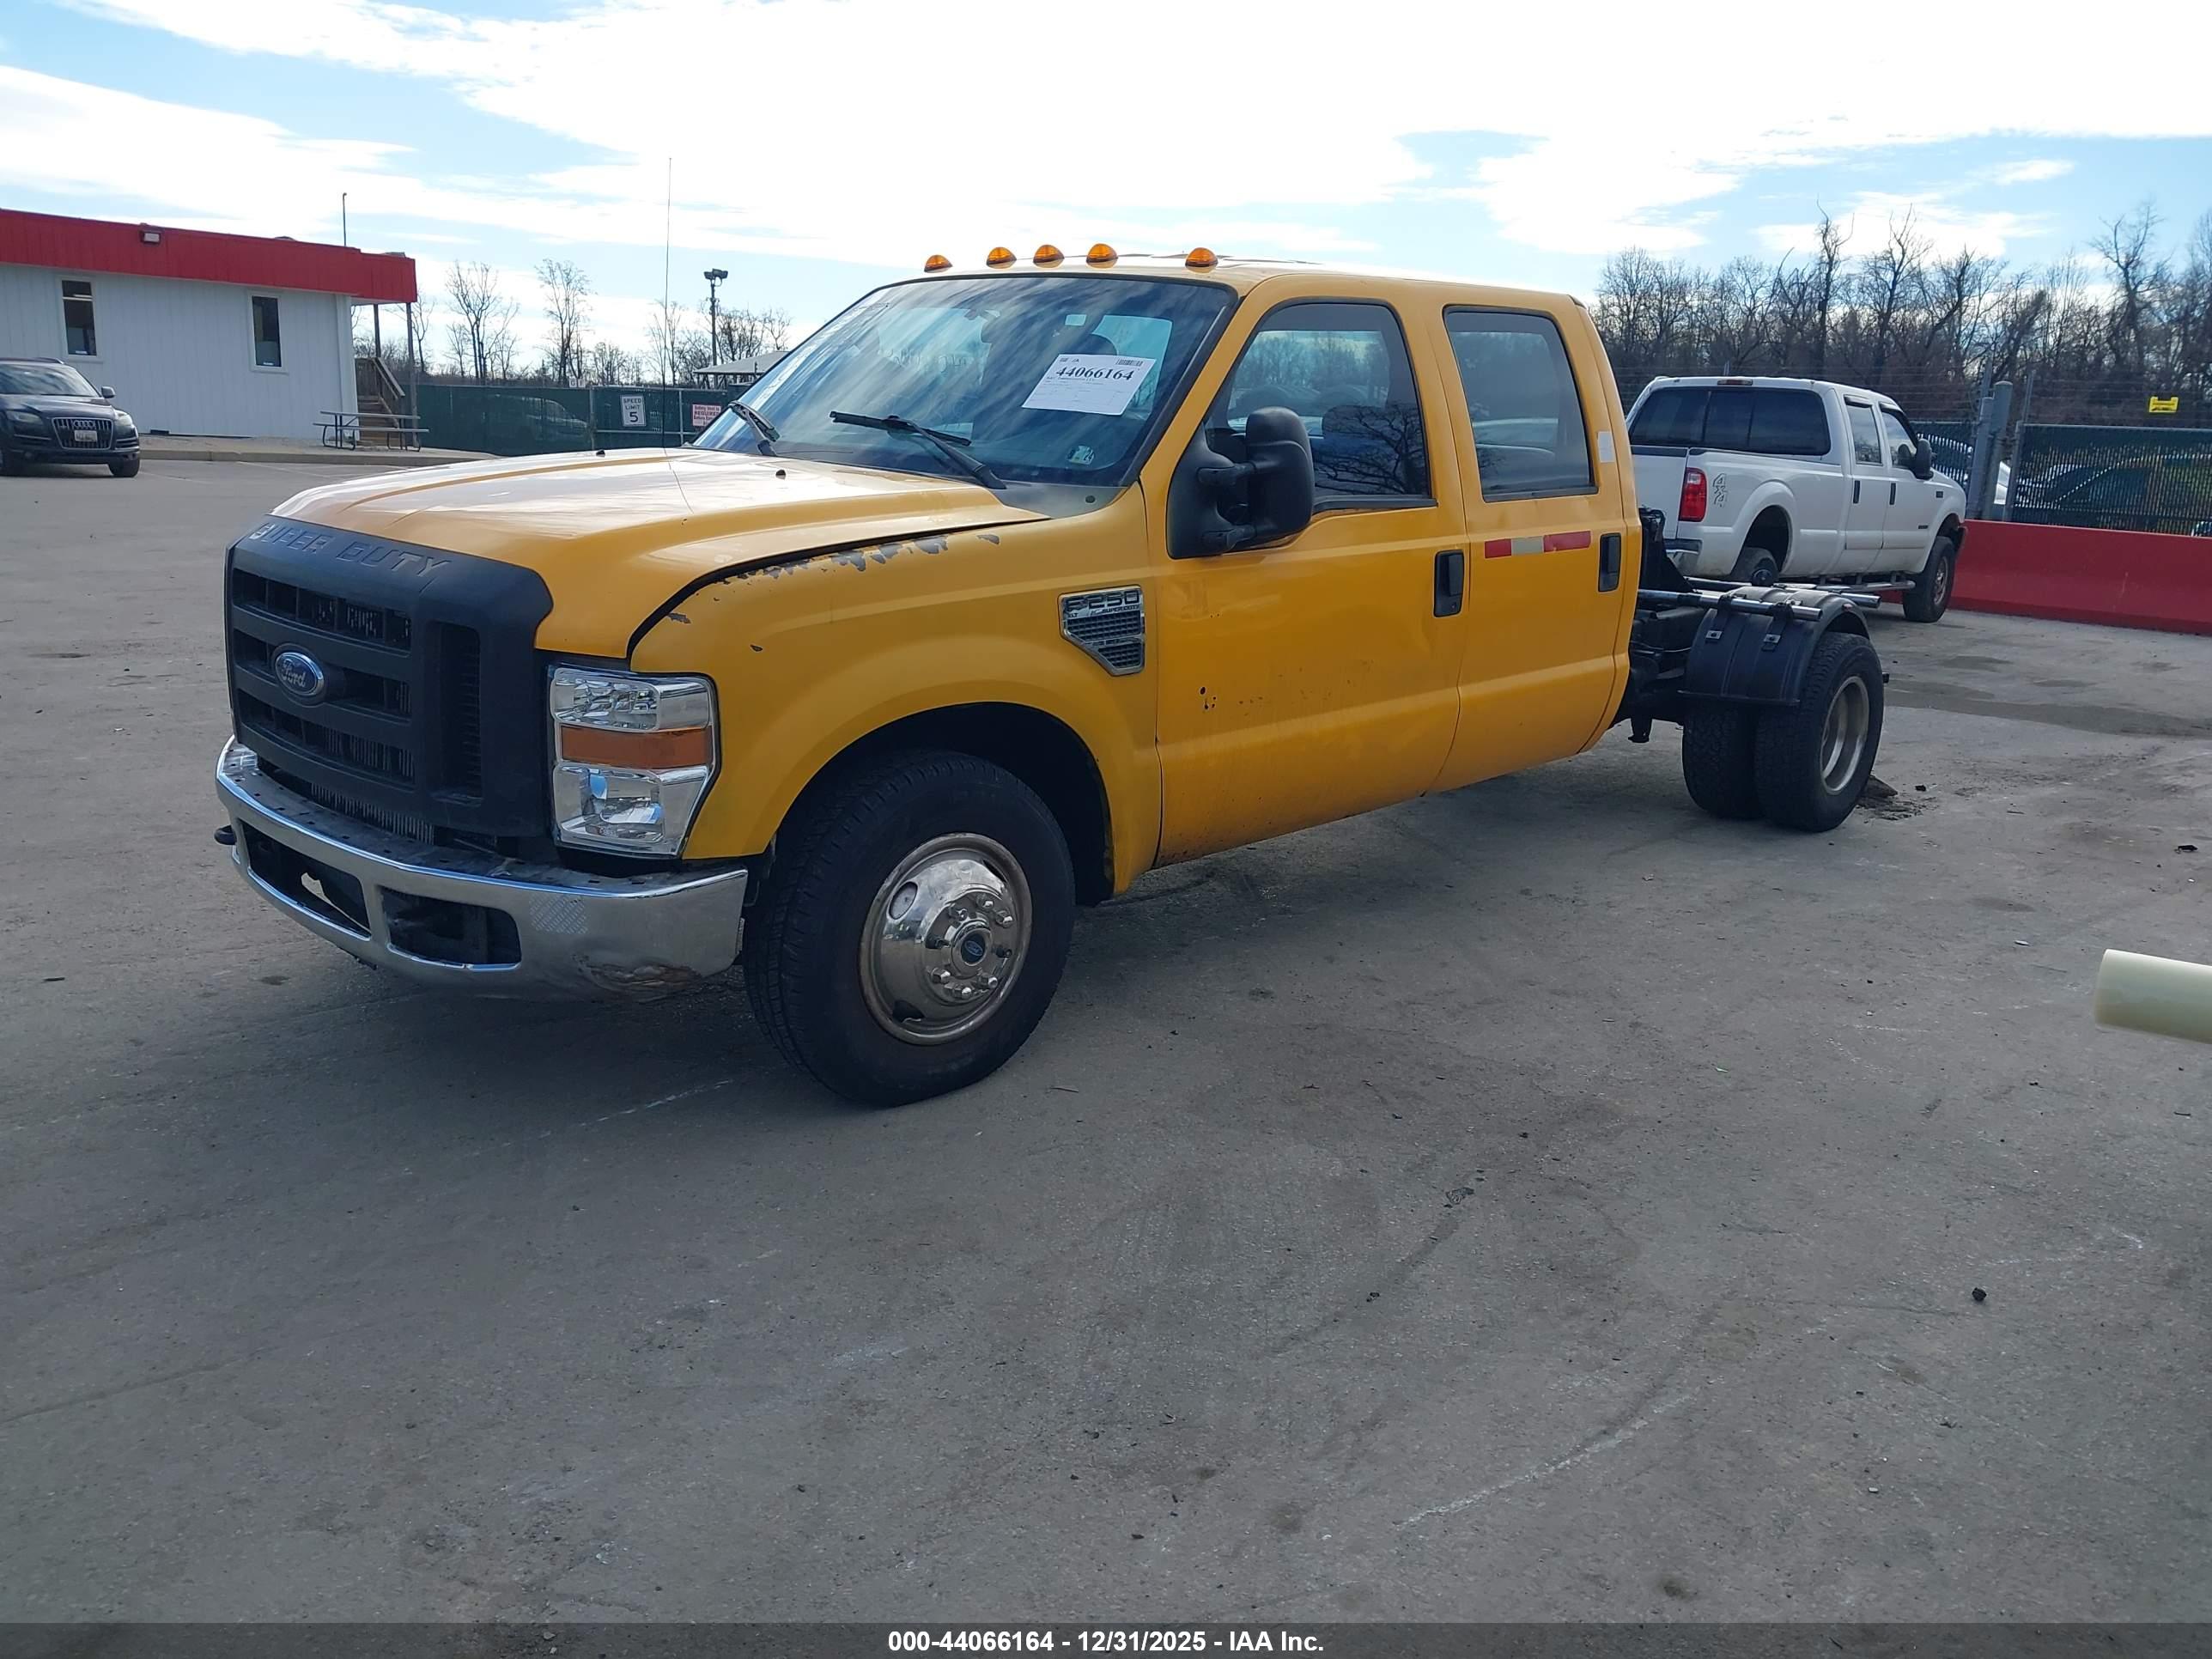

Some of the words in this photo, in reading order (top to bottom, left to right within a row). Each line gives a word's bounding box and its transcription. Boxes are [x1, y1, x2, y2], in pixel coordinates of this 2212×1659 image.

[1055, 366, 1135, 380] 44066164
[629, 411, 639, 422] 5
[249, 521, 334, 555] SUPER
[336, 540, 453, 578] DUTY
[281, 658, 307, 688] Ford
